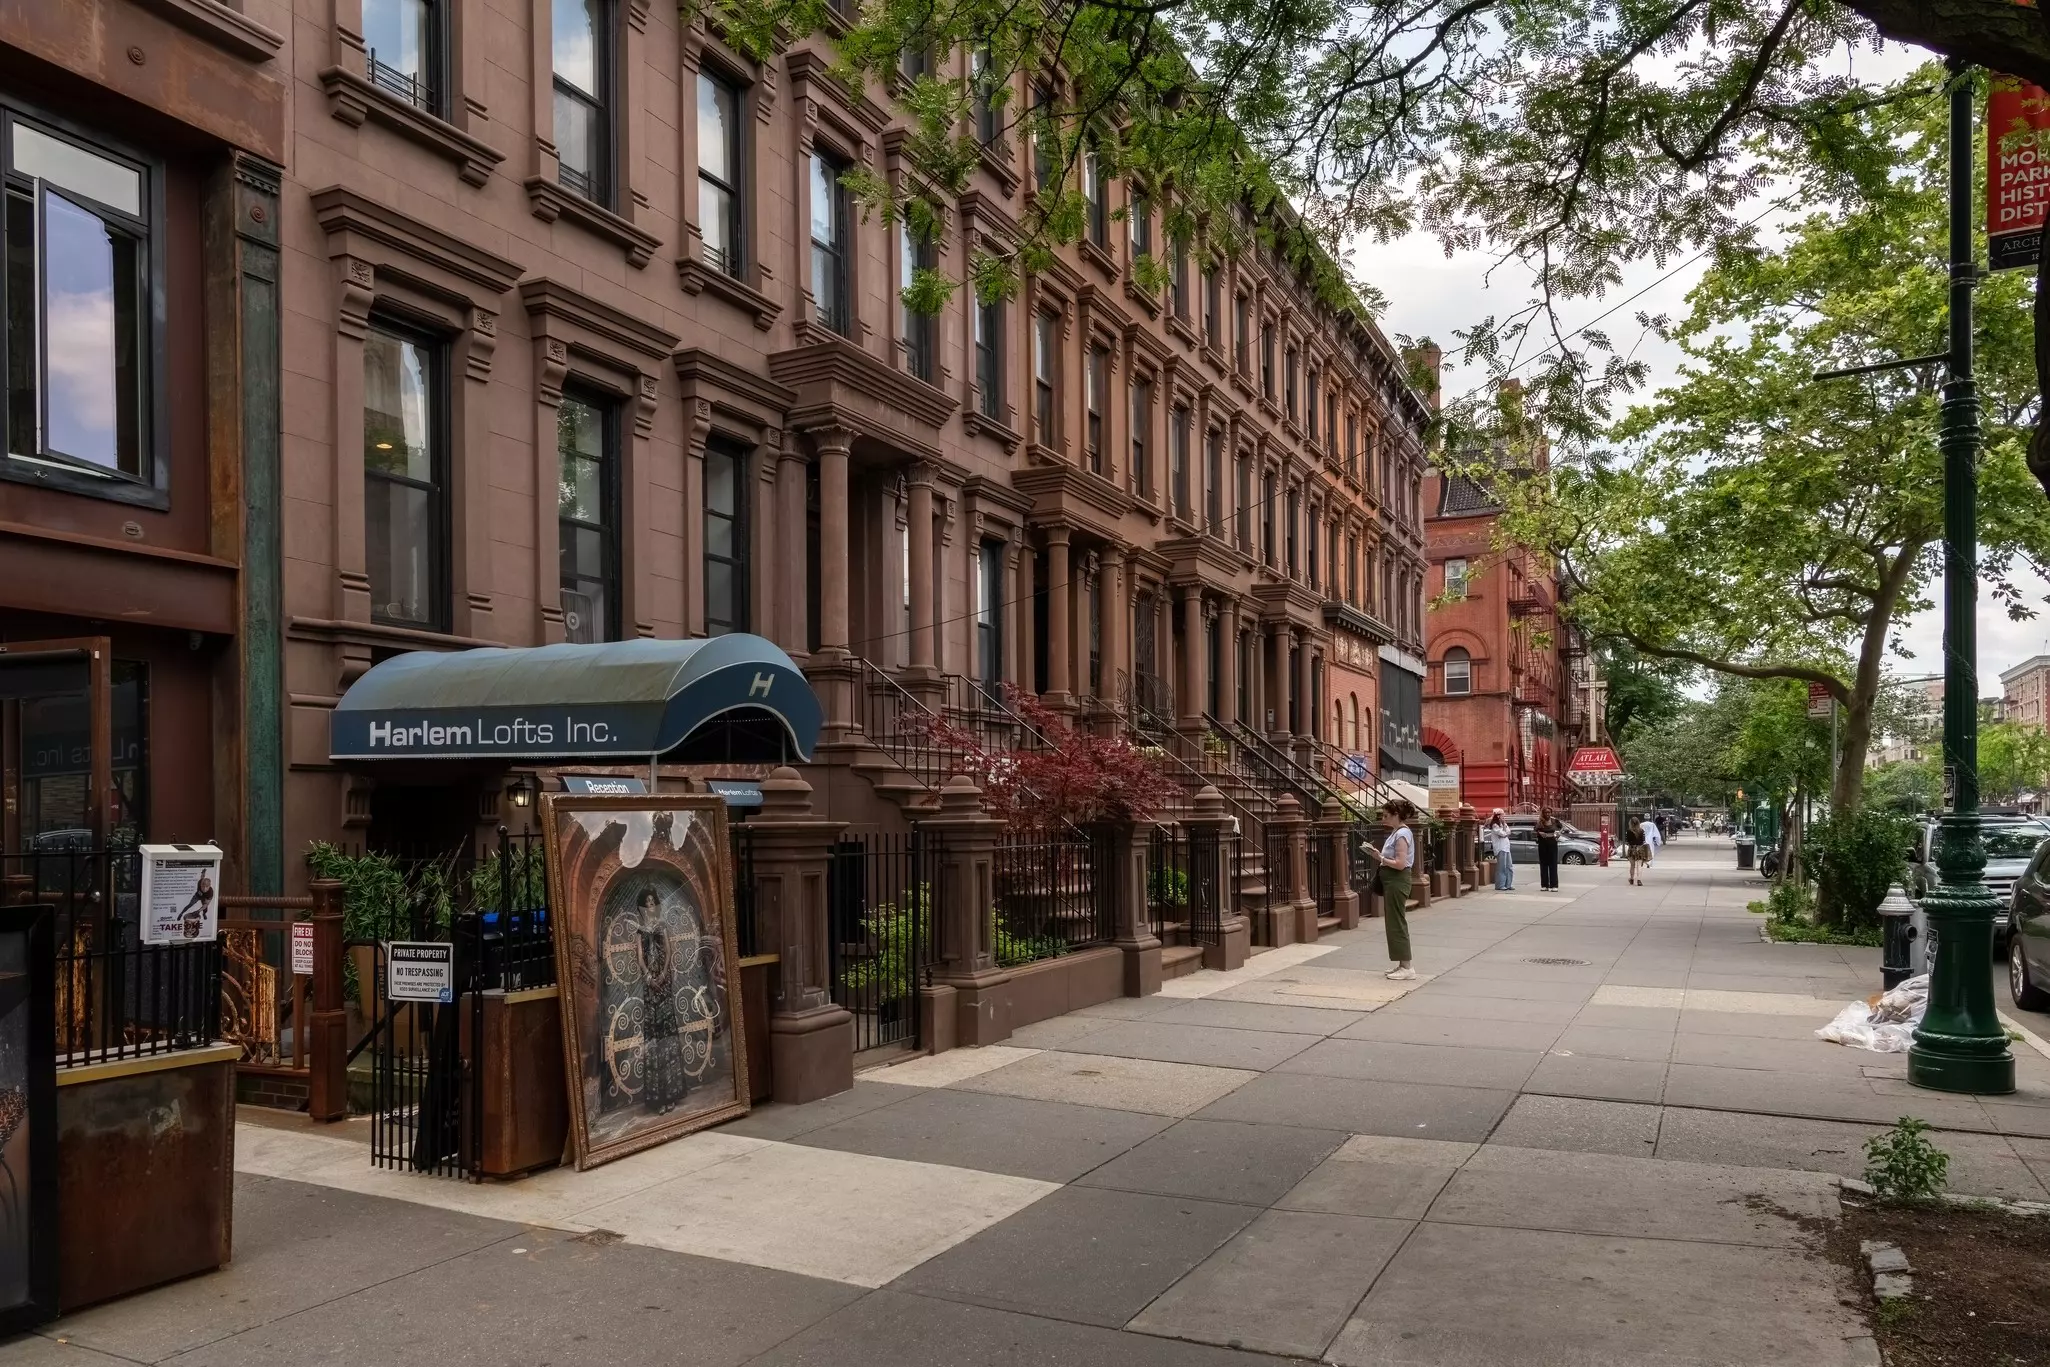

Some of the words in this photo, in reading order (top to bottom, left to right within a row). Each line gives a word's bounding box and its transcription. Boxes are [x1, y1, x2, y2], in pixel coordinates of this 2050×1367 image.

[2000, 183, 2050, 204] HIST
[2000, 201, 2049, 222] DIST
[2001, 236, 2040, 252] ARCH
[749, 671, 775, 698] H
[369, 720, 472, 747] Harlem
[478, 717, 553, 745] Lofts
[567, 716, 618, 743] Inc.
[1578, 754, 1607, 762] ATLAH
[585, 780, 630, 793] Reception
[718, 788, 742, 796] Harlem
[160, 922, 183, 932] TAKE
[295, 927, 305, 937] FIRE
[393, 948, 416, 958] PRIVATE
[416, 949, 447, 959] PROPERTY
[396, 967, 404, 976] NO
[405, 967, 444, 977] TRESPASSING
